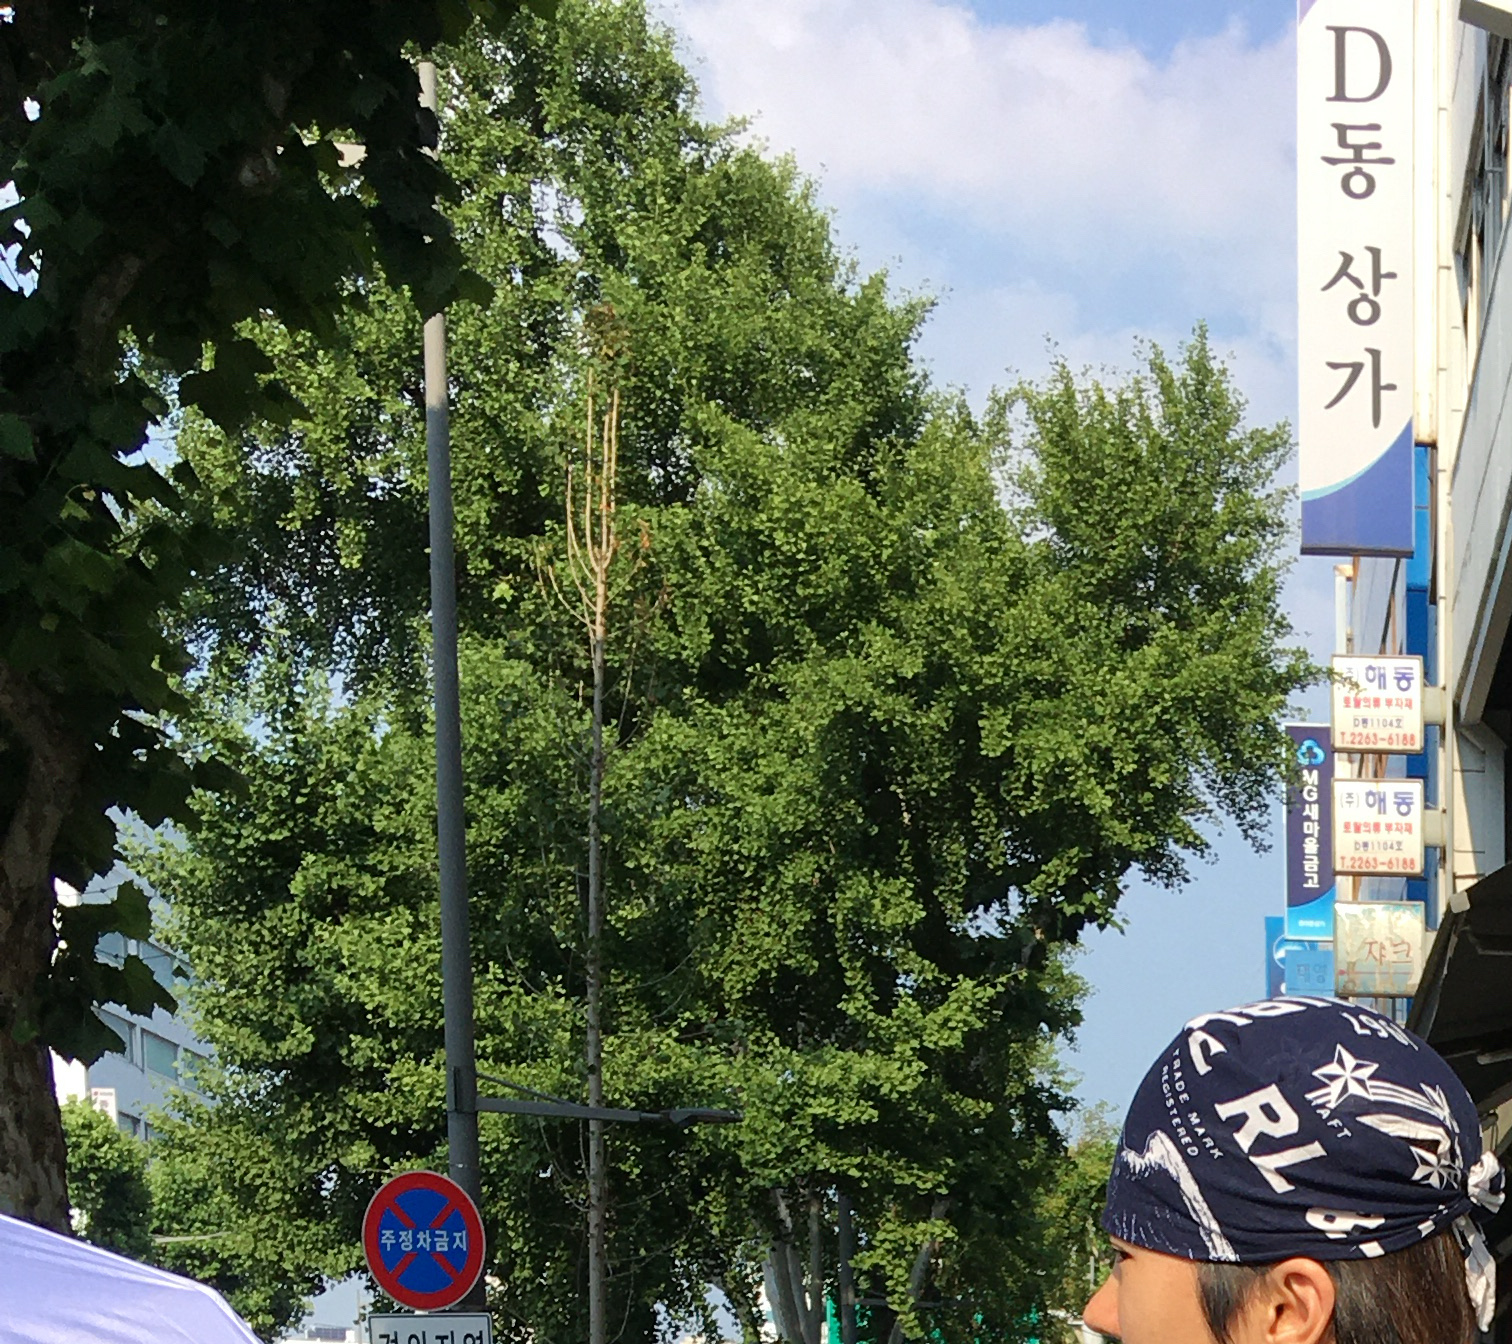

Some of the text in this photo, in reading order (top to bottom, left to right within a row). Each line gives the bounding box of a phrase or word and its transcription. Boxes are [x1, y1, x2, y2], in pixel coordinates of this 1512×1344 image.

[1320, 25, 1398, 429] D동 상가
[1339, 731, 1416, 747] T.2263-6188
[1302, 768, 1320, 888] MG새마을금고
[1365, 789, 1415, 817] 해동
[1339, 855, 1416, 871] T.2263-6188
[1161, 1064, 1199, 1157] REGISTERED
[1172, 1047, 1224, 1160] TRADE MARK
[380, 1228, 468, 1252] 주정차금지
